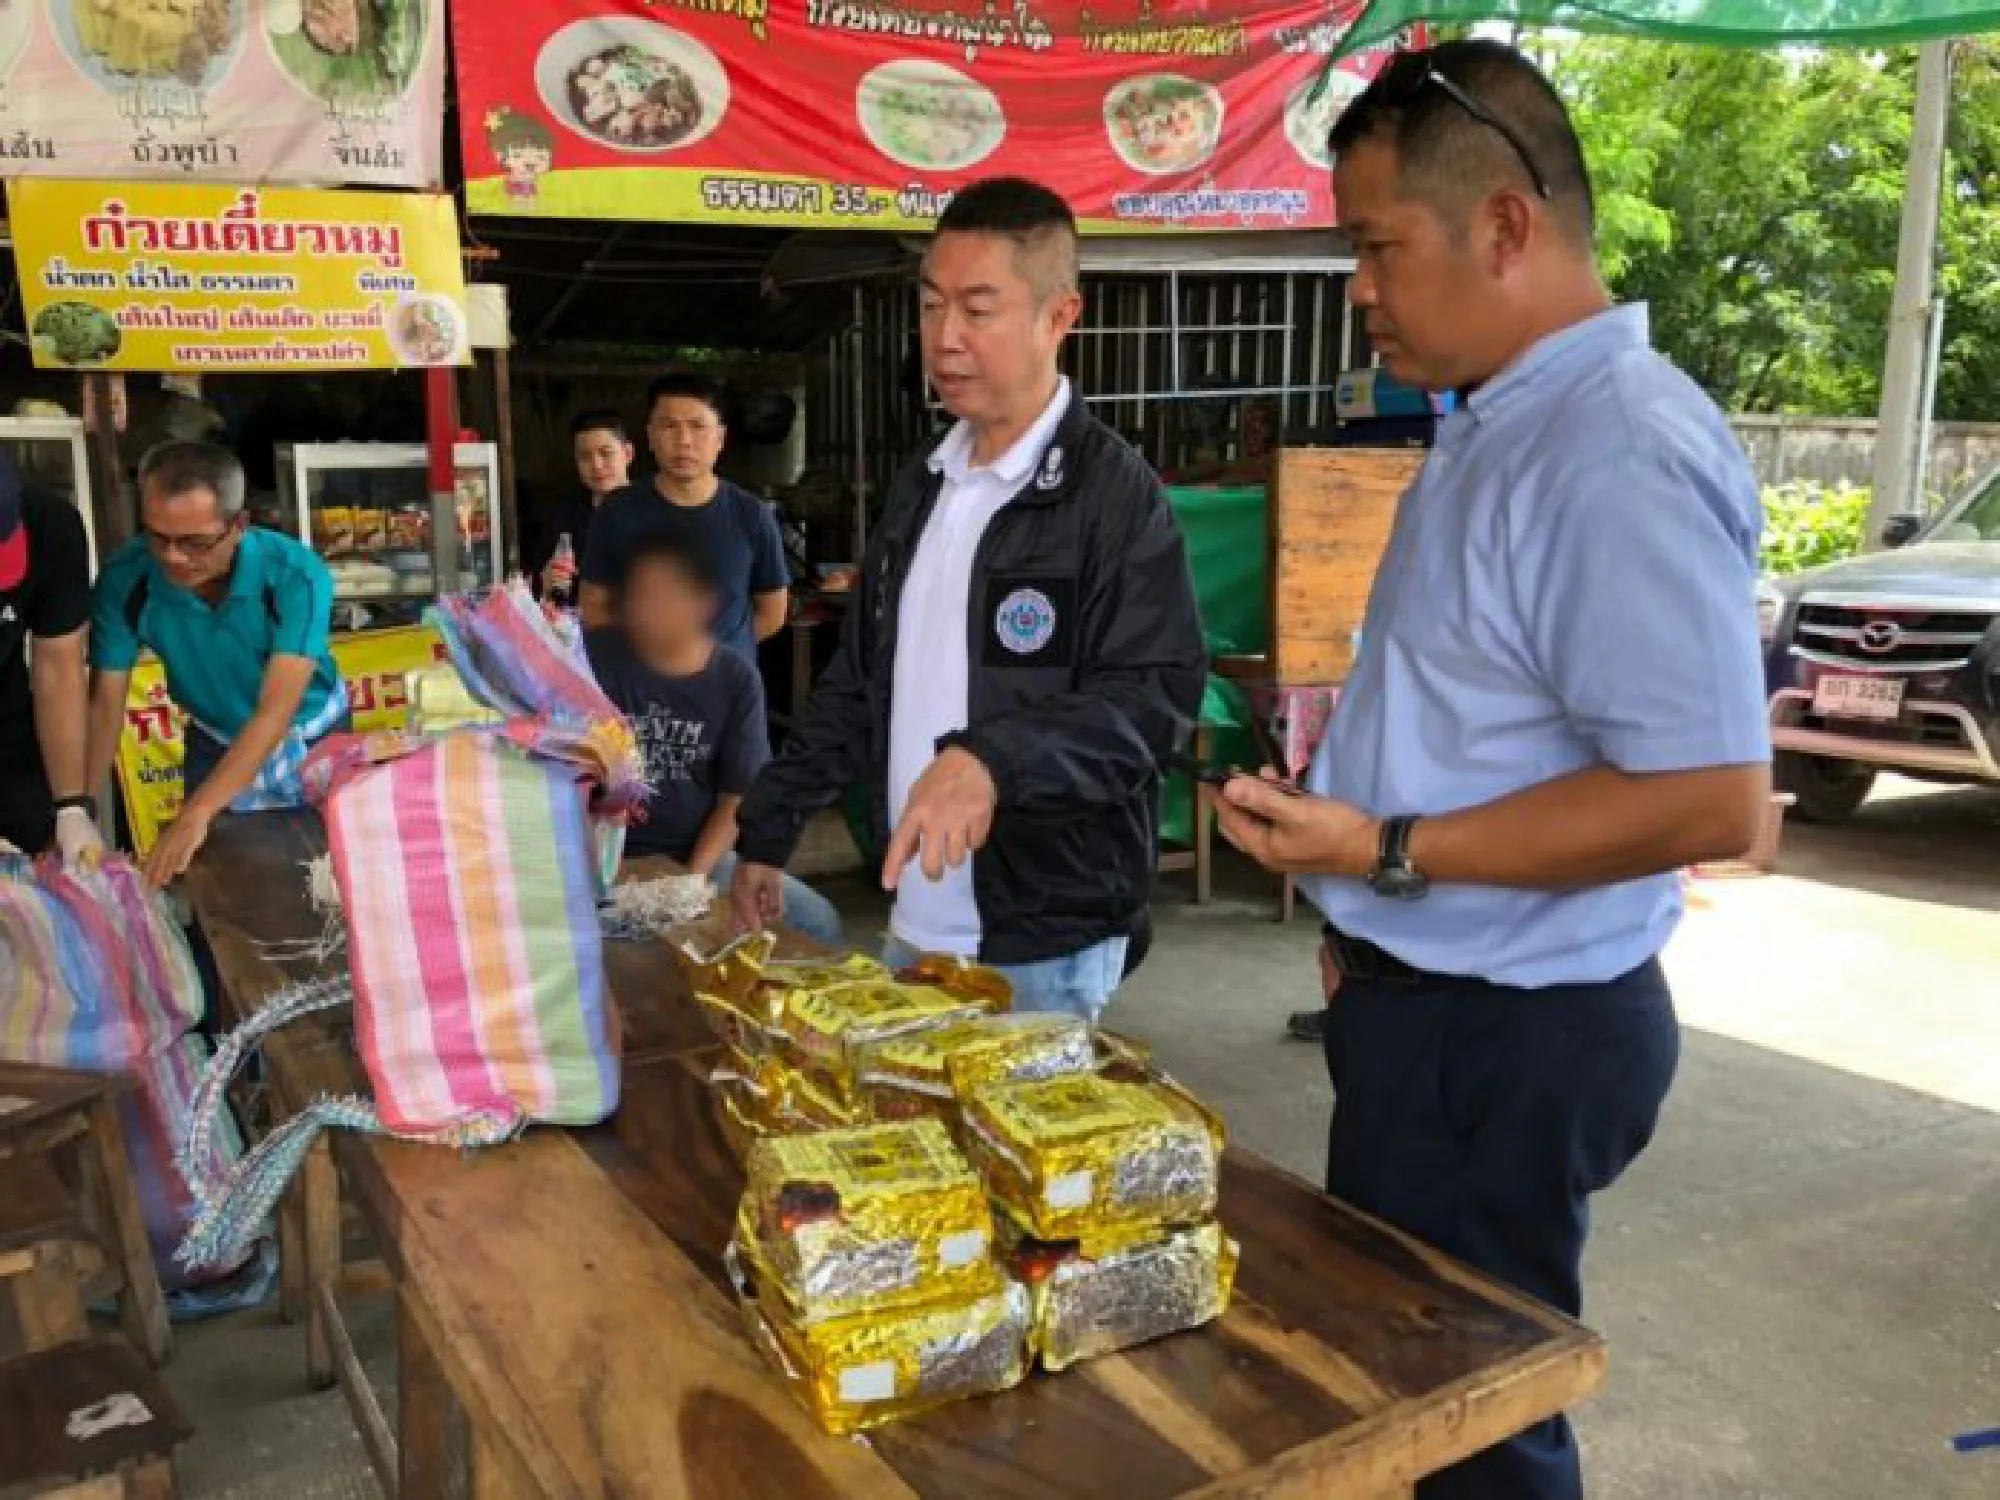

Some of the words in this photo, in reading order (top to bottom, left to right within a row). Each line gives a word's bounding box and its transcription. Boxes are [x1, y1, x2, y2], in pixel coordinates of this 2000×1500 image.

[85, 192, 401, 267] ก๋วยเตี๋ยวหมู
